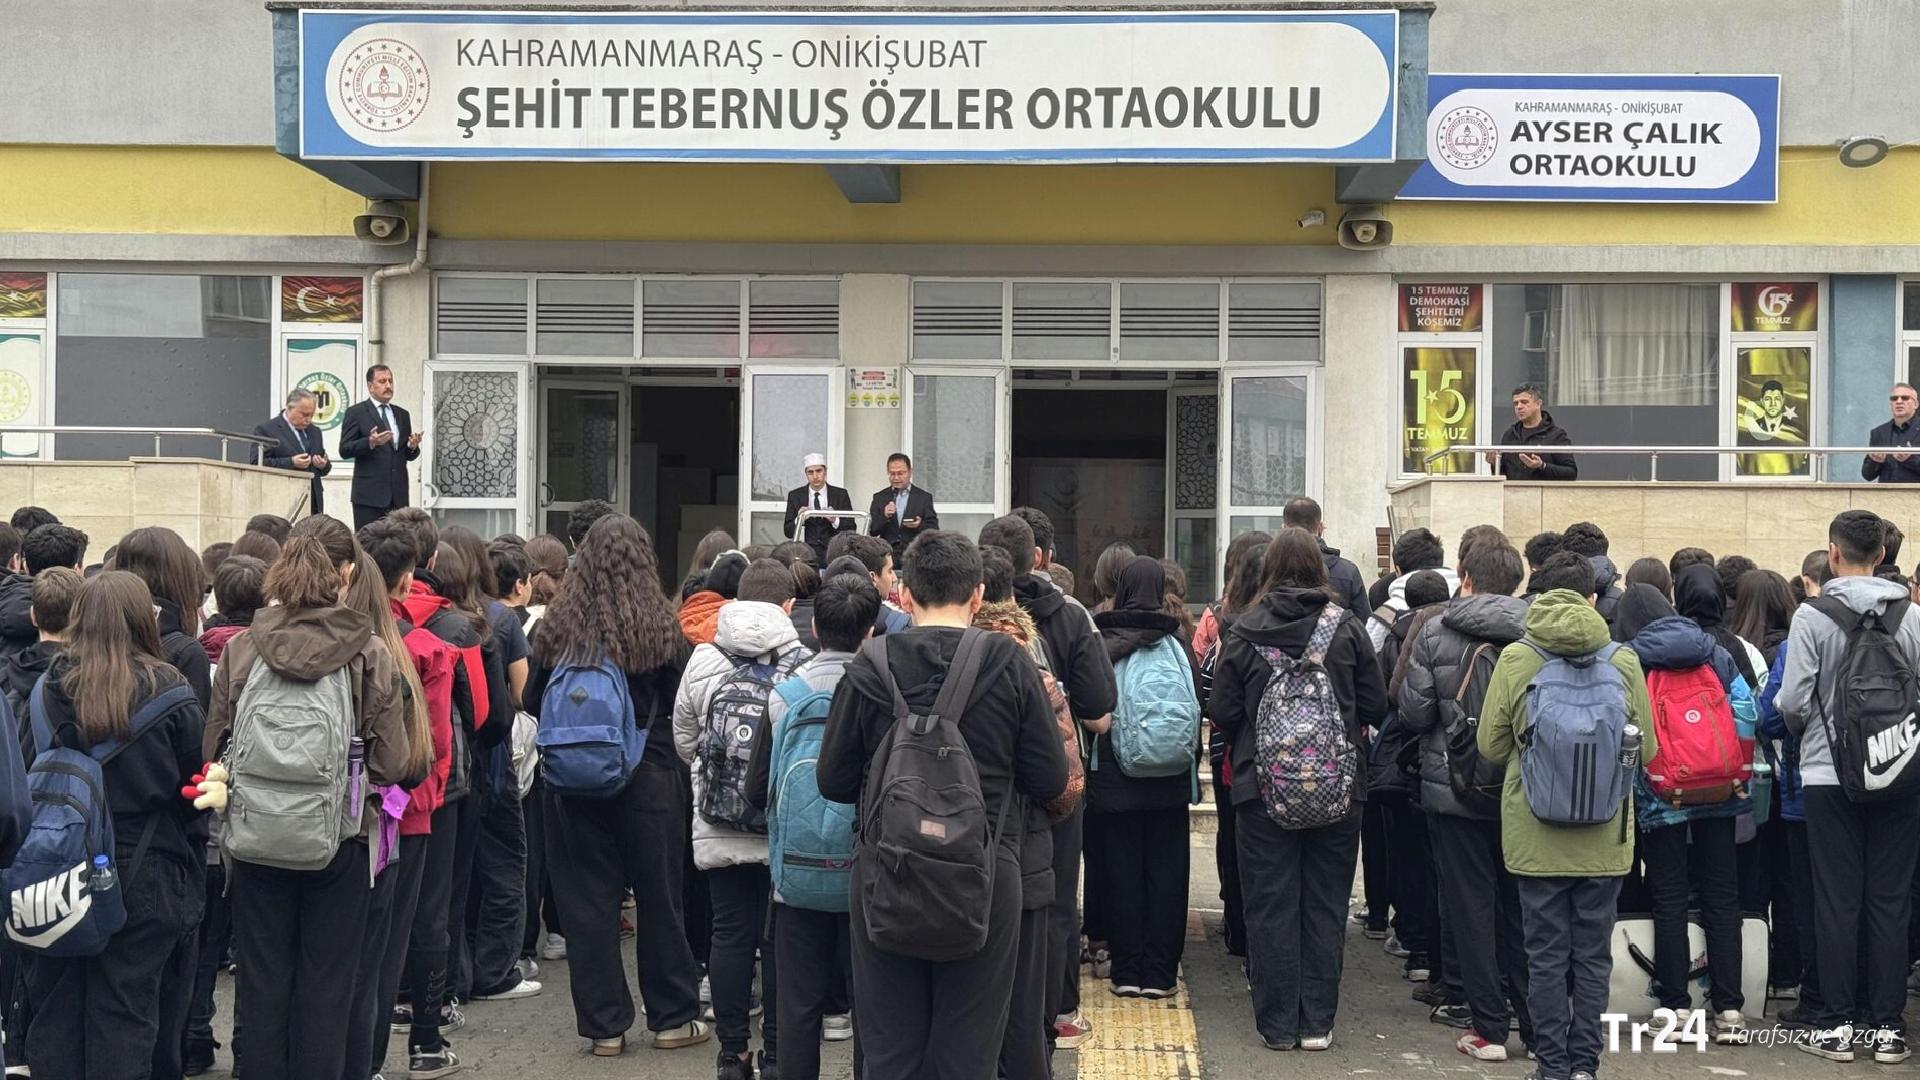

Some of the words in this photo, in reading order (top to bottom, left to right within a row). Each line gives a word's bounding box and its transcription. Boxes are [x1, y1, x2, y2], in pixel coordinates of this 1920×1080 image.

[457, 38, 762, 74] KAHRAMANMARAŞ
[793, 35, 987, 75] ONİKİŞUBAT
[457, 79, 591, 138] ŞEHİT
[602, 87, 848, 140] TEBERNUŞ
[862, 79, 1013, 129] ÖZLER
[1027, 87, 1320, 129] ORTAOKULU
[1515, 101, 1612, 117] KAHRAMANMARAŞ
[1622, 101, 1683, 116] ONİKİŞUBAT
[1510, 121, 1612, 144] AYSER
[1623, 122, 1722, 150] ÇALIK
[1510, 154, 1695, 177] ORTAOKULU
[1409, 294, 1469, 306] DEMOKRASİ
[1411, 286, 1424, 294] 15
[1426, 286, 1469, 295] TEMMUZ
[1415, 306, 1464, 317] ŞEHİTLERİ
[1417, 316, 1462, 328] KÖŞEMİZ
[1755, 316, 1791, 325] TEMMUZ
[1410, 370, 1466, 425] 15
[1867, 712, 1917, 768] NIKE
[11, 861, 91, 929] NIKE
